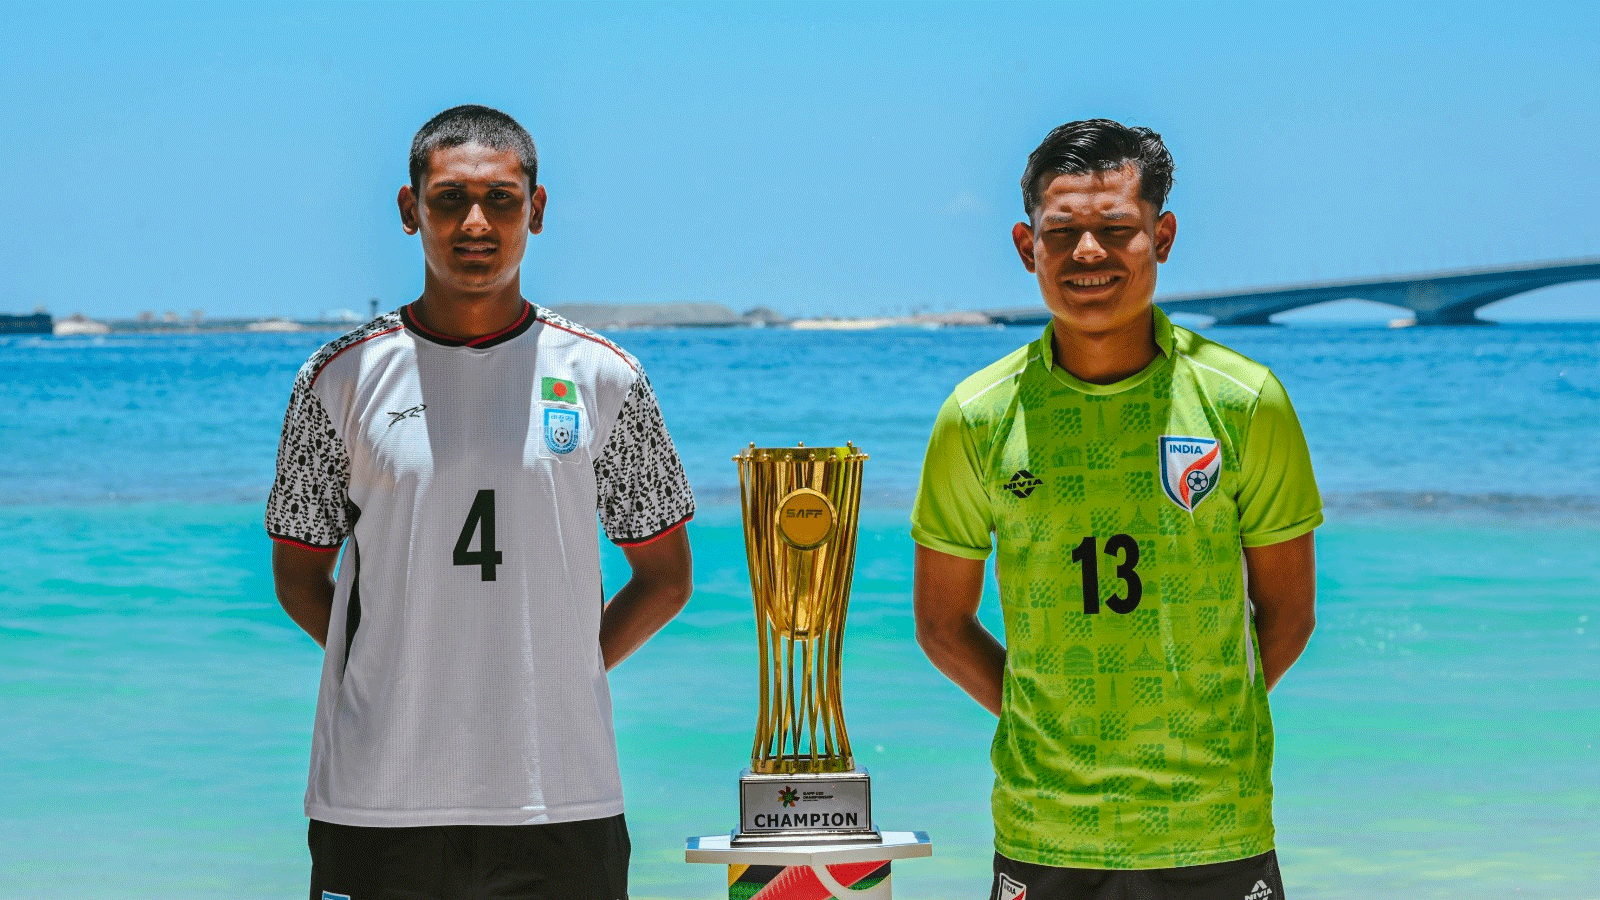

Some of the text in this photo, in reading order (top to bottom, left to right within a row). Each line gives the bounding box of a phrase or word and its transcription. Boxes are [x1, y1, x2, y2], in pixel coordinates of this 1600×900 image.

[1169, 444, 1203, 454] INDIA
[1002, 479, 1043, 490] NIVIA
[786, 509, 822, 518] SAFF
[453, 489, 502, 581] 4
[1072, 534, 1142, 614] 13
[754, 812, 858, 828] CHAMPION
